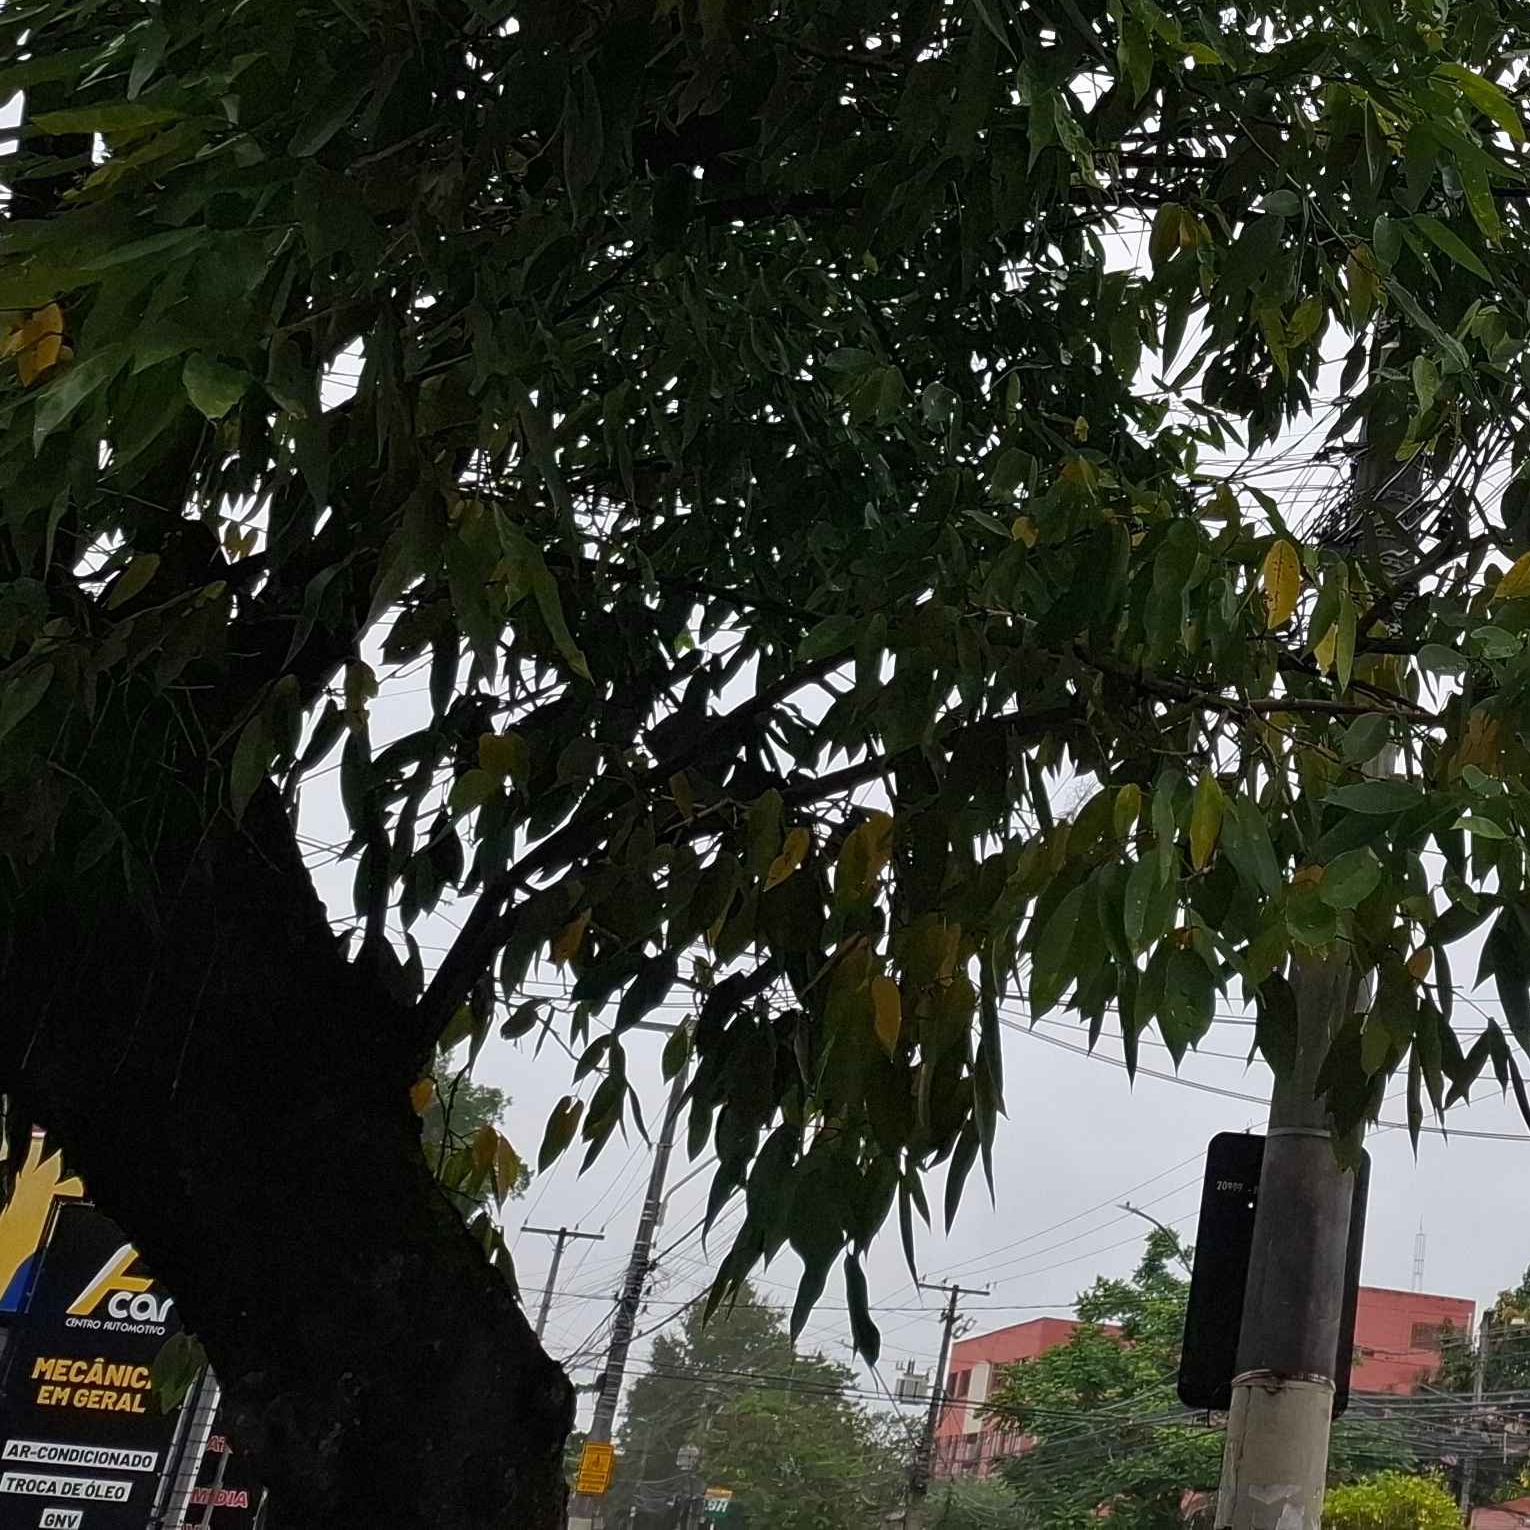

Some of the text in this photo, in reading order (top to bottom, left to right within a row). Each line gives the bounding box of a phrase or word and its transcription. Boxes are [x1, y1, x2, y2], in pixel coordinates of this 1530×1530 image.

[64, 1317, 166, 1336] CENTRO AUTOMOTIVO
[36, 1386, 147, 1413] EM GERAL
[6, 1443, 154, 1469] AR-CONDICIONADO
[5, 1476, 126, 1501] TROCA DE ÓLEO
[43, 1511, 80, 1529] GNV
